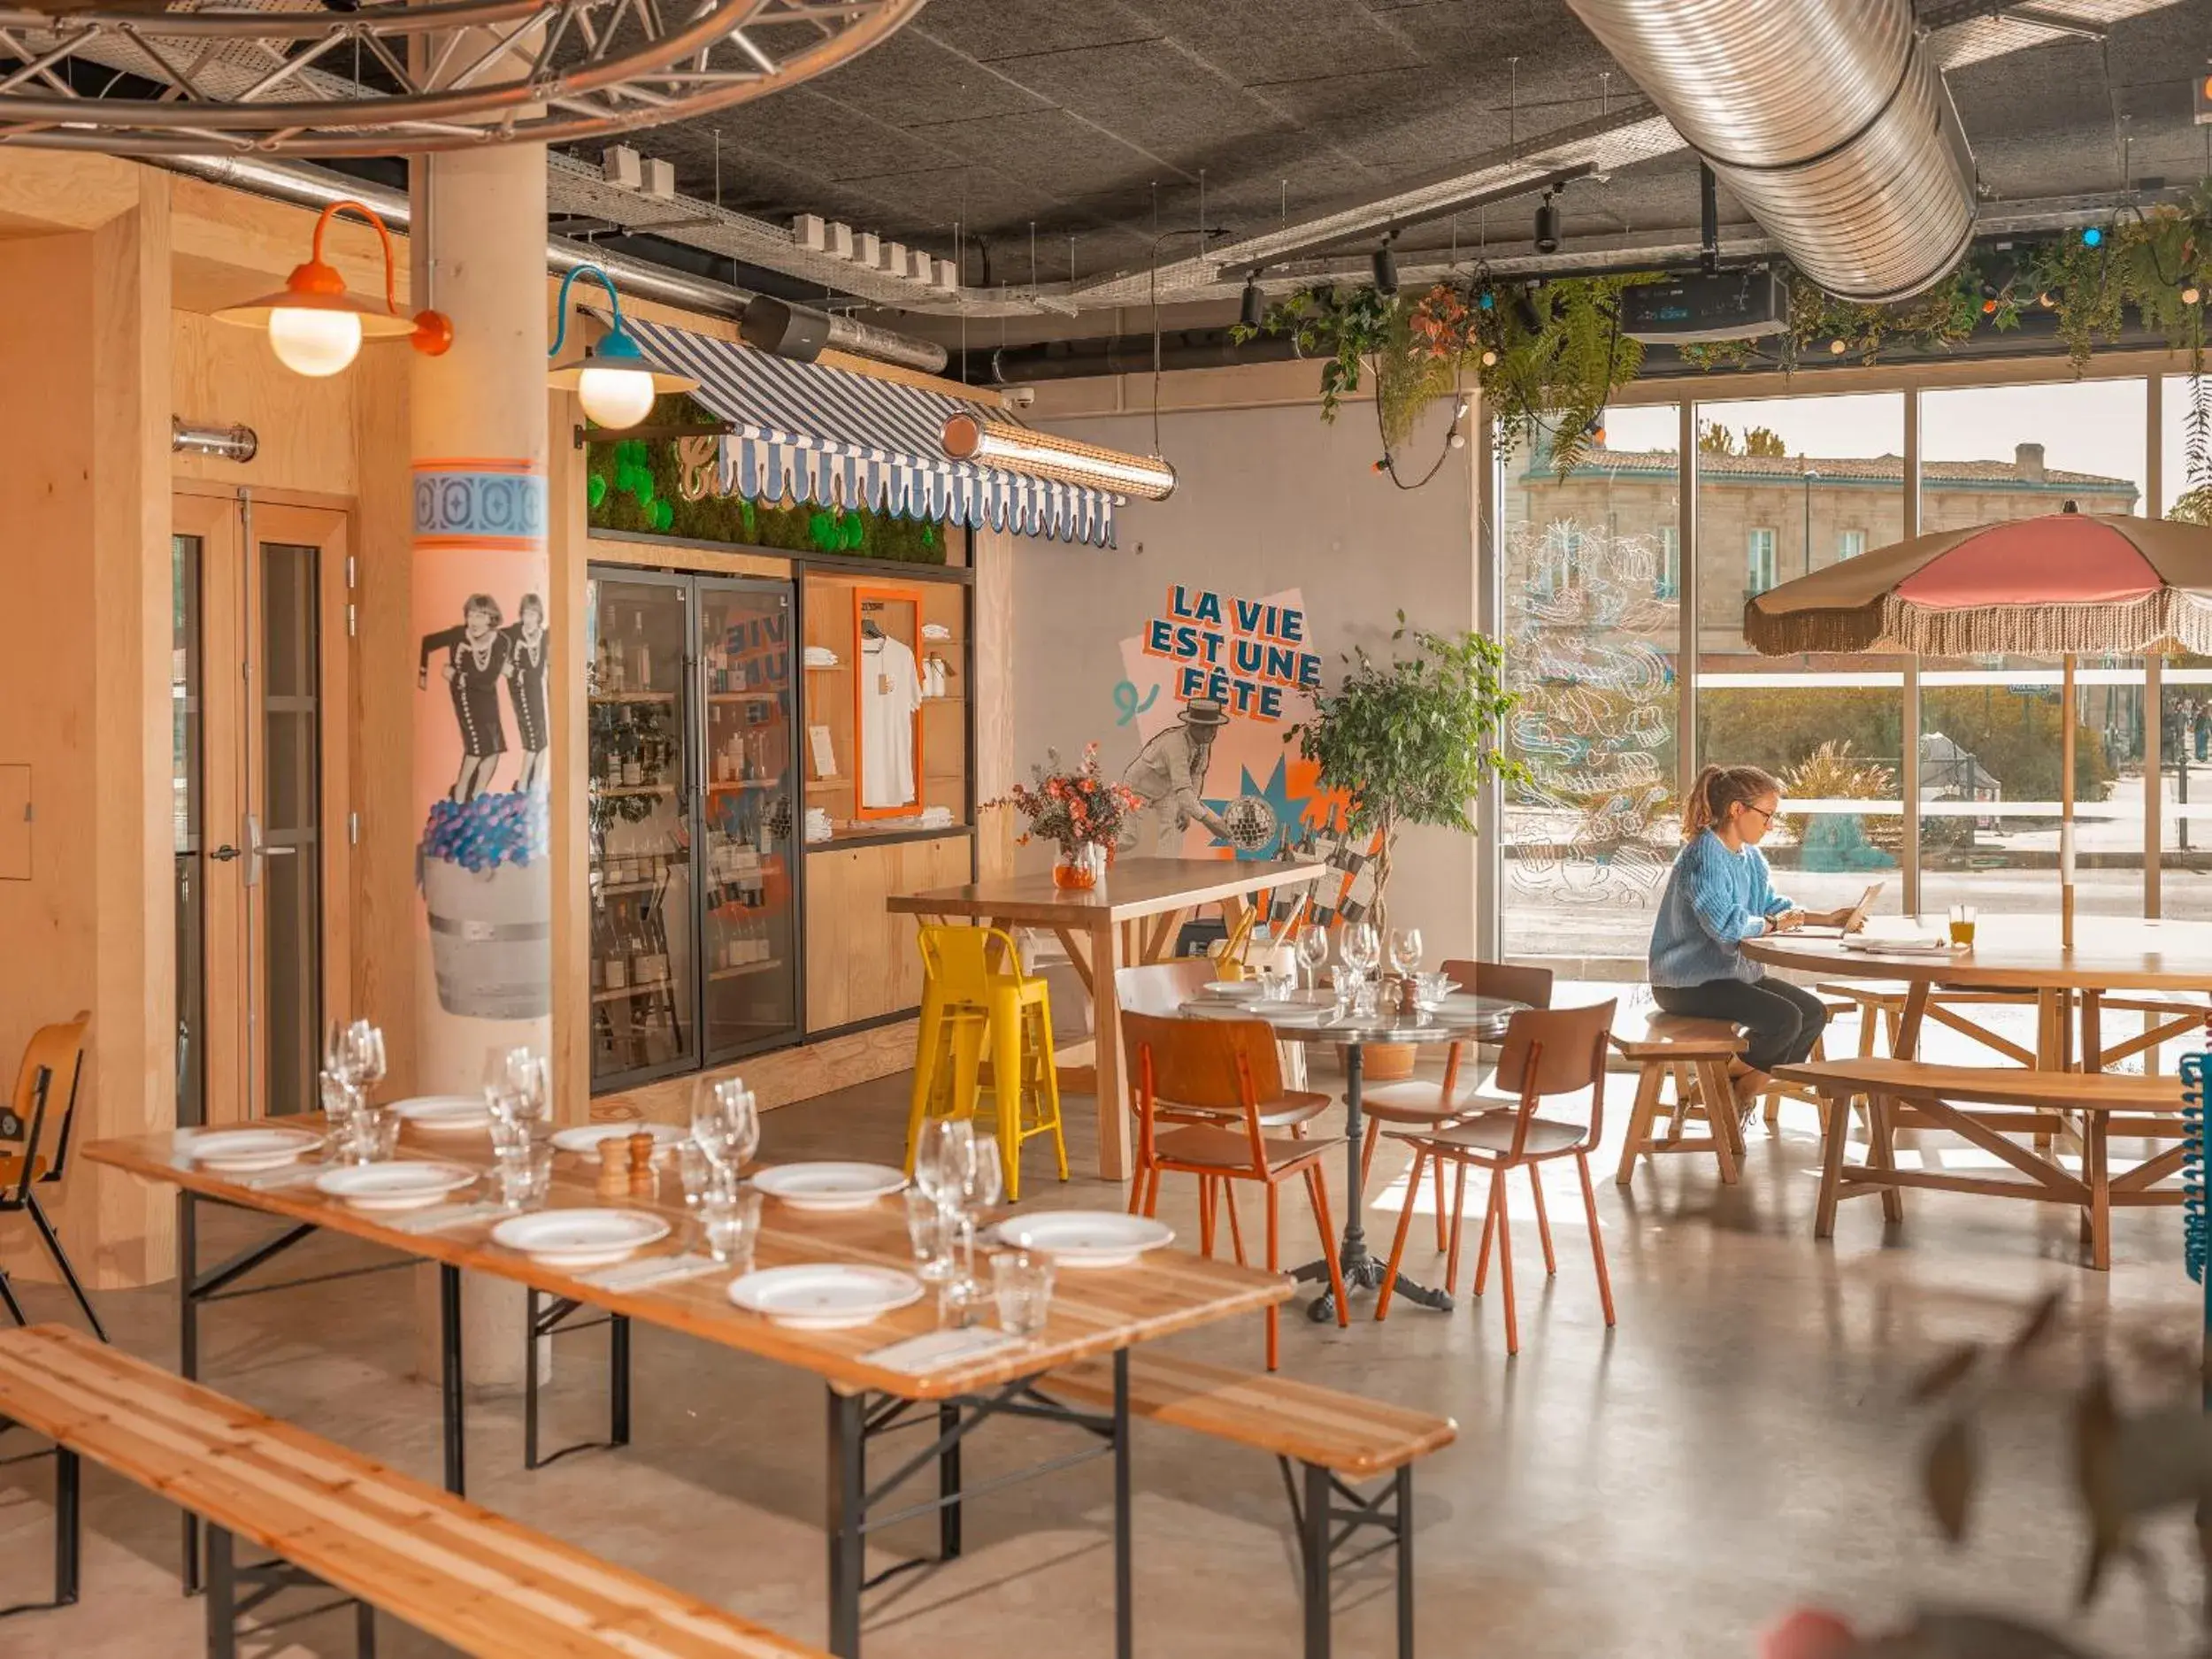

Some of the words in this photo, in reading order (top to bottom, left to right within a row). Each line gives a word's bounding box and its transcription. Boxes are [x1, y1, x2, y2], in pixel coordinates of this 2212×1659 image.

[1168, 584, 1222, 628] LA
[1228, 599, 1303, 647] VIE
[1142, 619, 1225, 666] EST
[1229, 639, 1322, 687] UNE
[1174, 665, 1283, 721] FÊTE
